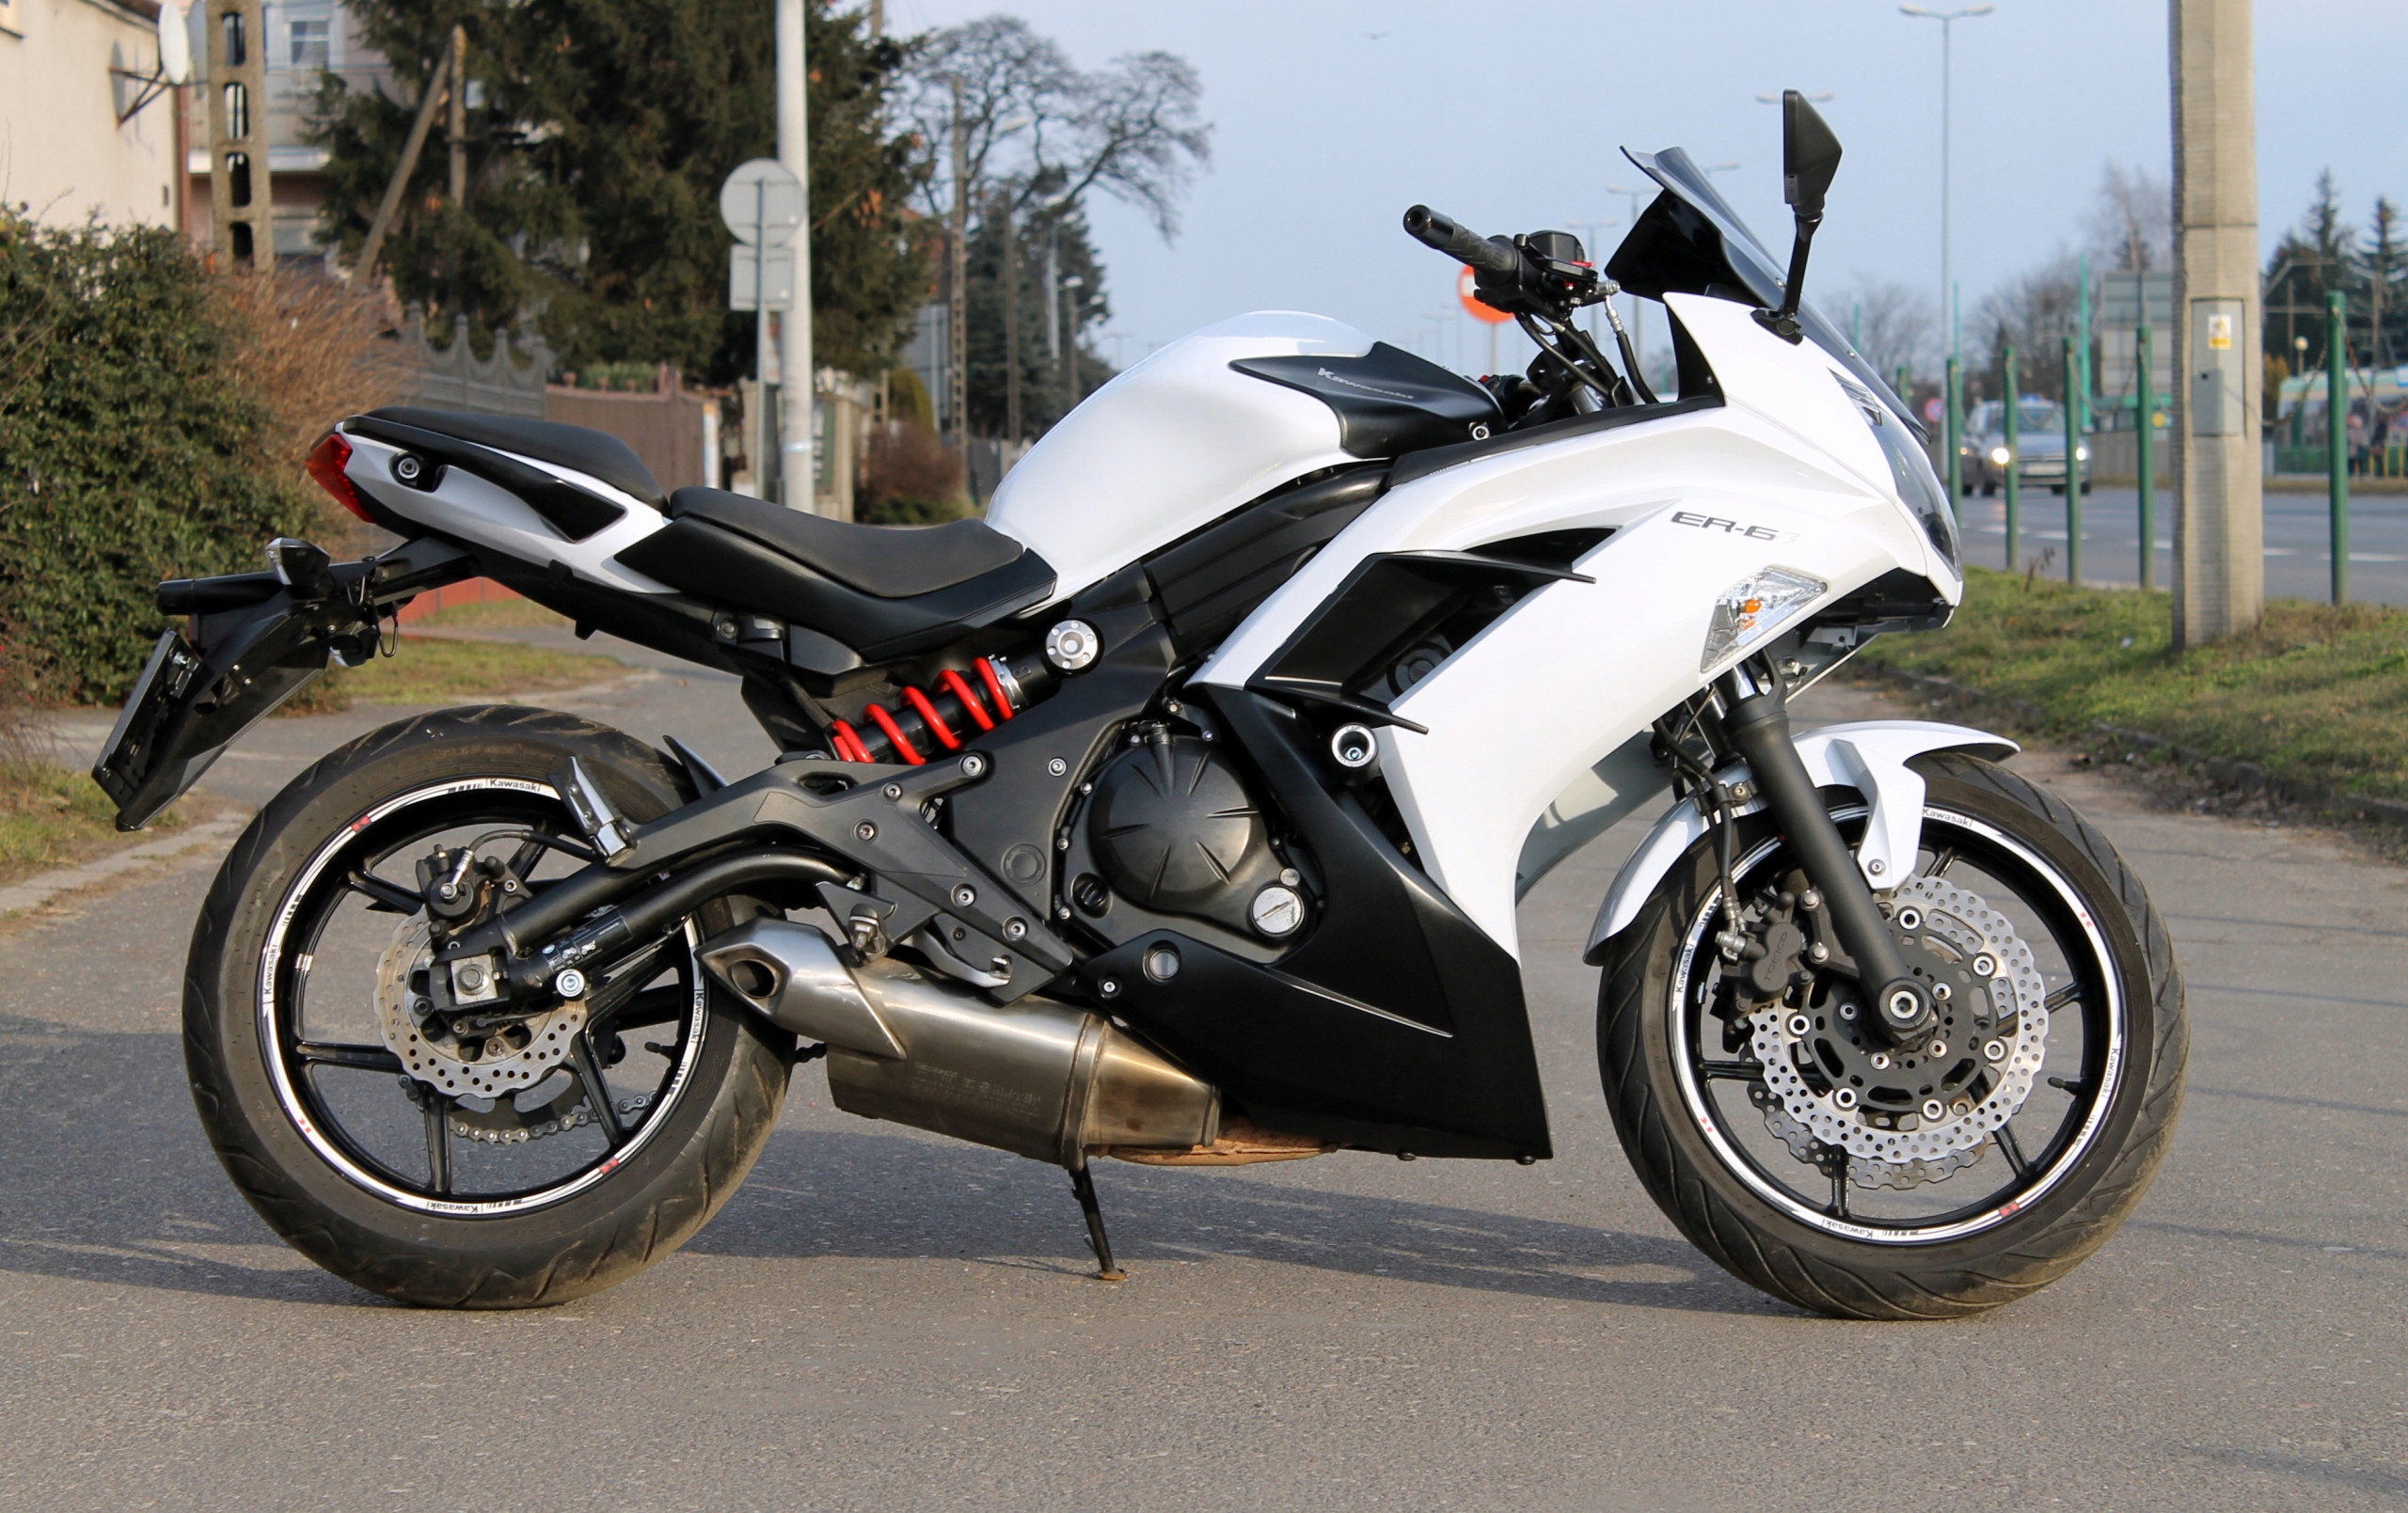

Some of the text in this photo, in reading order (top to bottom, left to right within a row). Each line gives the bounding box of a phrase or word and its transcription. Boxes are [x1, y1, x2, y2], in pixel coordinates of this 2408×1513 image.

[489, 778, 541, 792] Kawasaki
[1922, 808, 1973, 828] Kawasaki
[263, 944, 278, 995] Kawasaki
[1675, 943, 1695, 993] Kawasaki
[689, 992, 705, 1044] Kawasaki
[2100, 1048, 2120, 1099] Kawasaki
[426, 1201, 479, 1214] Kawasaki
[1821, 1218, 1875, 1239] Kawasaki
